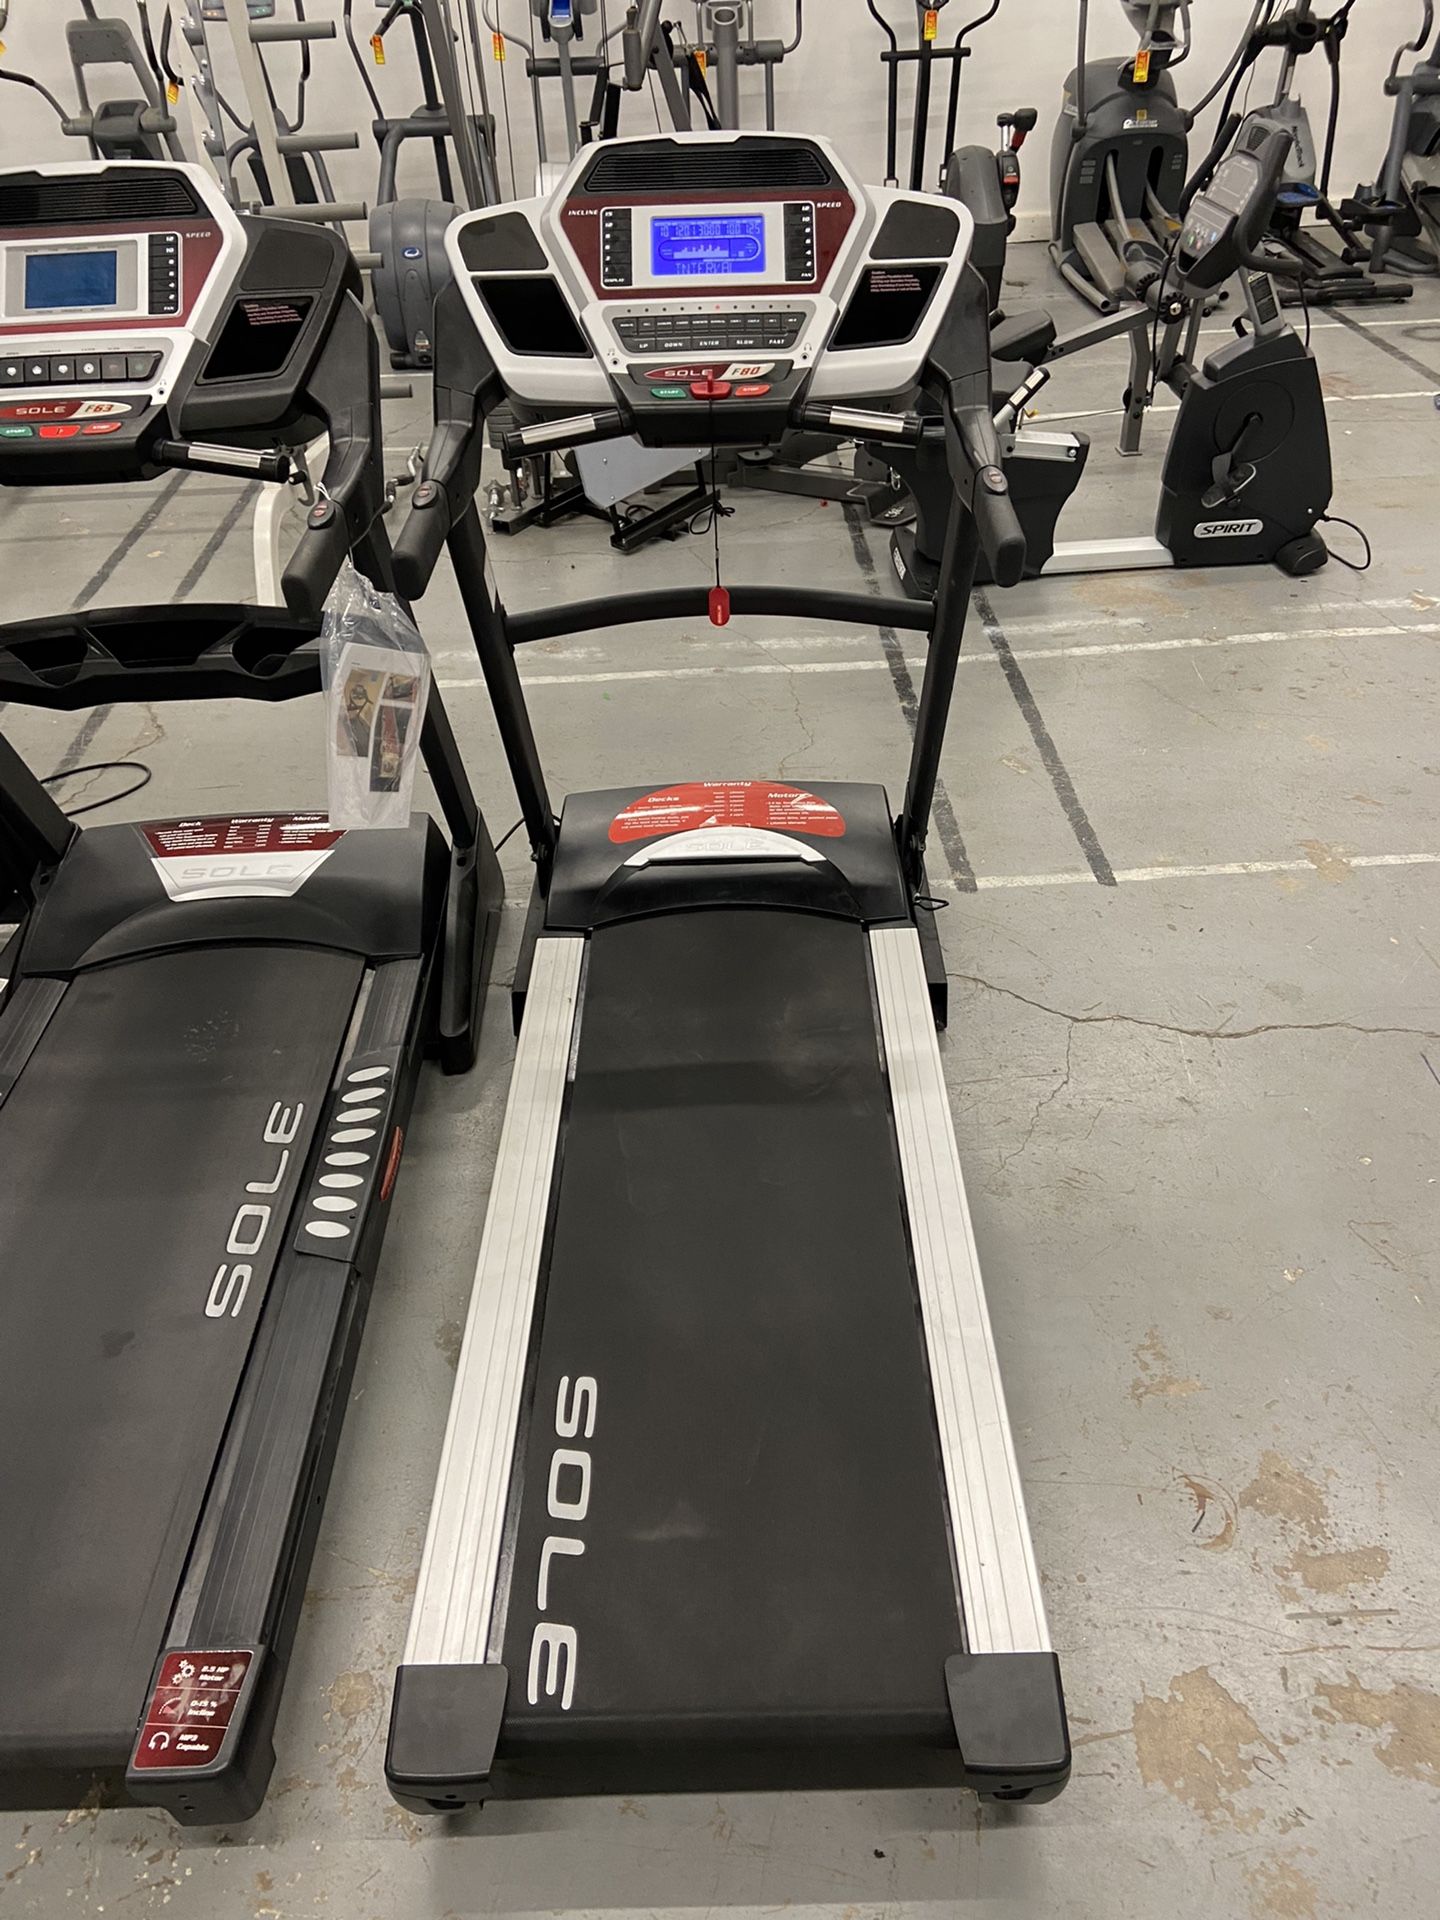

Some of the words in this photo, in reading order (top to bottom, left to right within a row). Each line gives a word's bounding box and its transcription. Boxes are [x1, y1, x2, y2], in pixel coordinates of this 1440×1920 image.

[568, 209, 598, 217] INCLINE
[665, 369, 713, 377] SOLE
[732, 366, 761, 376] F80
[16, 405, 66, 415] SOLE
[85, 404, 114, 413] F63
[1200, 522, 1257, 536] SPIRIT
[231, 817, 275, 825] Warranty
[181, 864, 293, 880] SOLE
[204, 1100, 304, 1318] SOLE
[527, 1375, 598, 1711] SOLE
[198, 1673, 225, 1682] Motor
[187, 1708, 215, 1717] Incline
[178, 1733, 199, 1742] MP3
[175, 1742, 210, 1752] Capable
